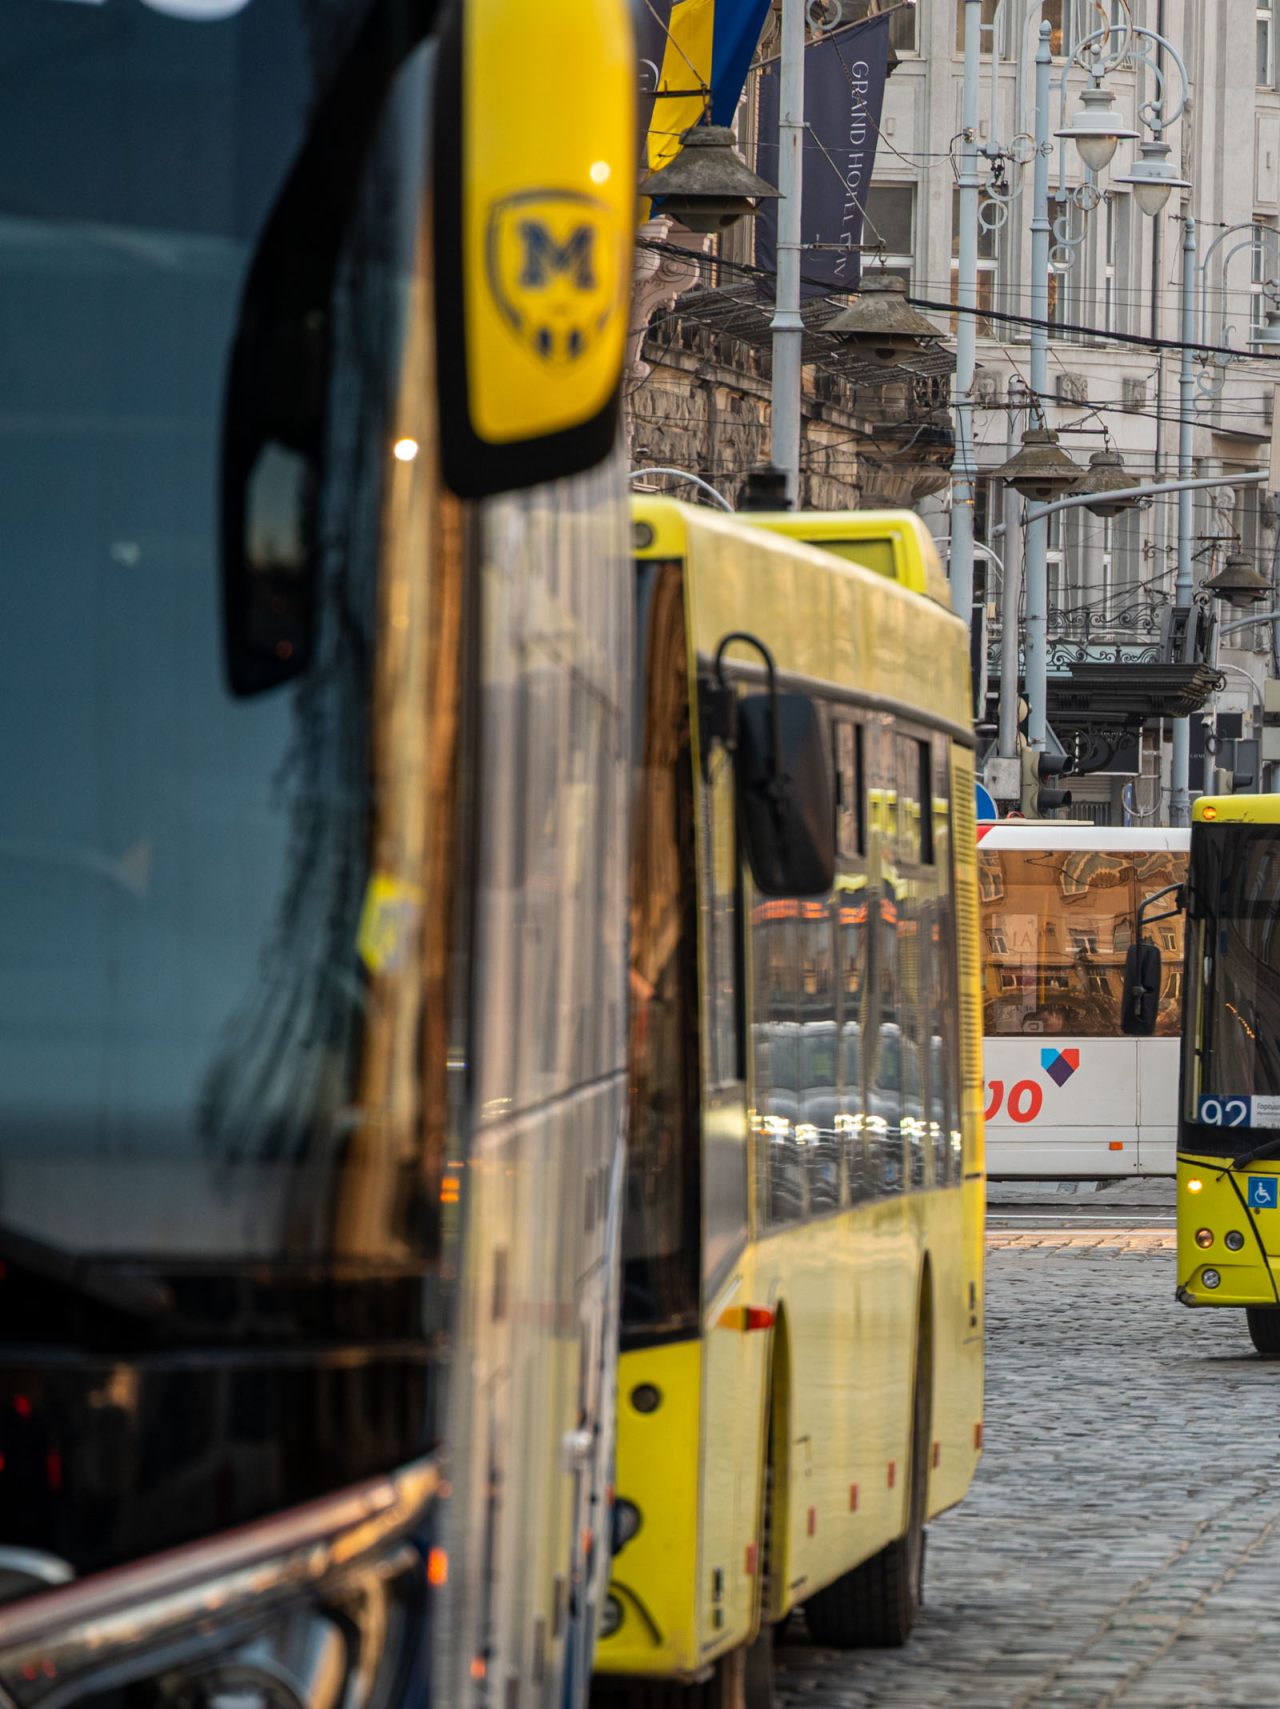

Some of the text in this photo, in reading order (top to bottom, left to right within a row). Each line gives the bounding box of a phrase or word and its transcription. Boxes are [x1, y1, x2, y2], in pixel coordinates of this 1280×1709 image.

[850, 60, 869, 145] GRAND
[842, 152, 864, 226] HOTEL
[1200, 1099, 1248, 1127] 92
